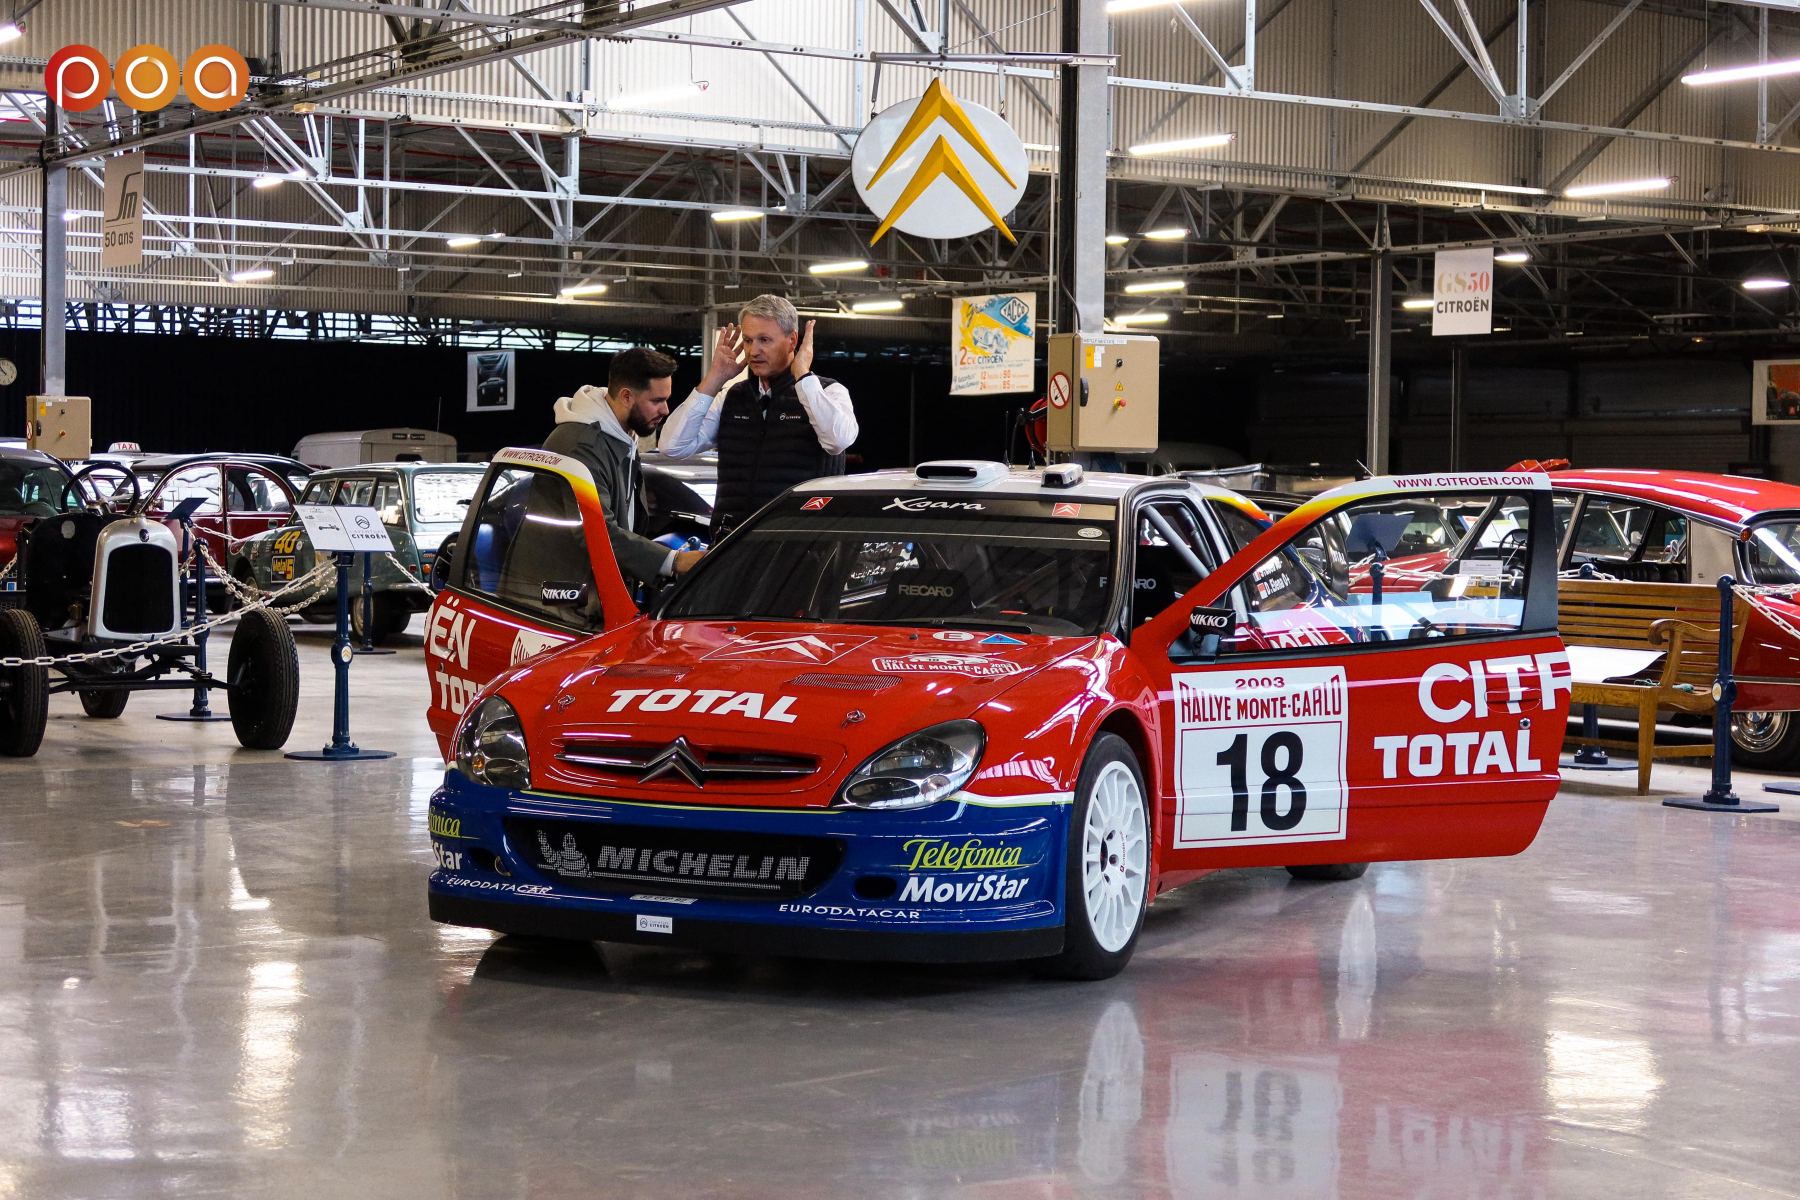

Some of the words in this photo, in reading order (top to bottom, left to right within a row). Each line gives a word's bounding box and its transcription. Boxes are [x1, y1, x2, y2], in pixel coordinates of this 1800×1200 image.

[104, 230, 117, 248] 50
[118, 231, 134, 246] ans
[1436, 296, 1490, 314] CITROËN
[116, 442, 139, 451] TAXI
[502, 450, 562, 466] WWW.CITROEN.COM
[1393, 476, 1534, 489] WWW.CITROEN.COM
[881, 496, 986, 512] Xsara
[273, 530, 301, 554] 40
[541, 587, 579, 600] NIKKO
[898, 584, 954, 598] RECARO
[1189, 612, 1228, 628] NIKKO
[943, 632, 963, 641] E
[881, 661, 925, 671] RALLYE
[1235, 676, 1285, 691] 2003
[605, 688, 798, 724] TOTAL
[1178, 680, 1231, 724] RALLYE
[1236, 674, 1342, 721] MONTE-CARLO
[1373, 729, 1541, 779] TOTAL
[1216, 730, 1307, 832] 18
[597, 845, 811, 881] MICHELIN
[446, 877, 552, 896] EURODATACAR
[898, 873, 1029, 903] MoviStar
[778, 903, 919, 919] EURODATACAR
